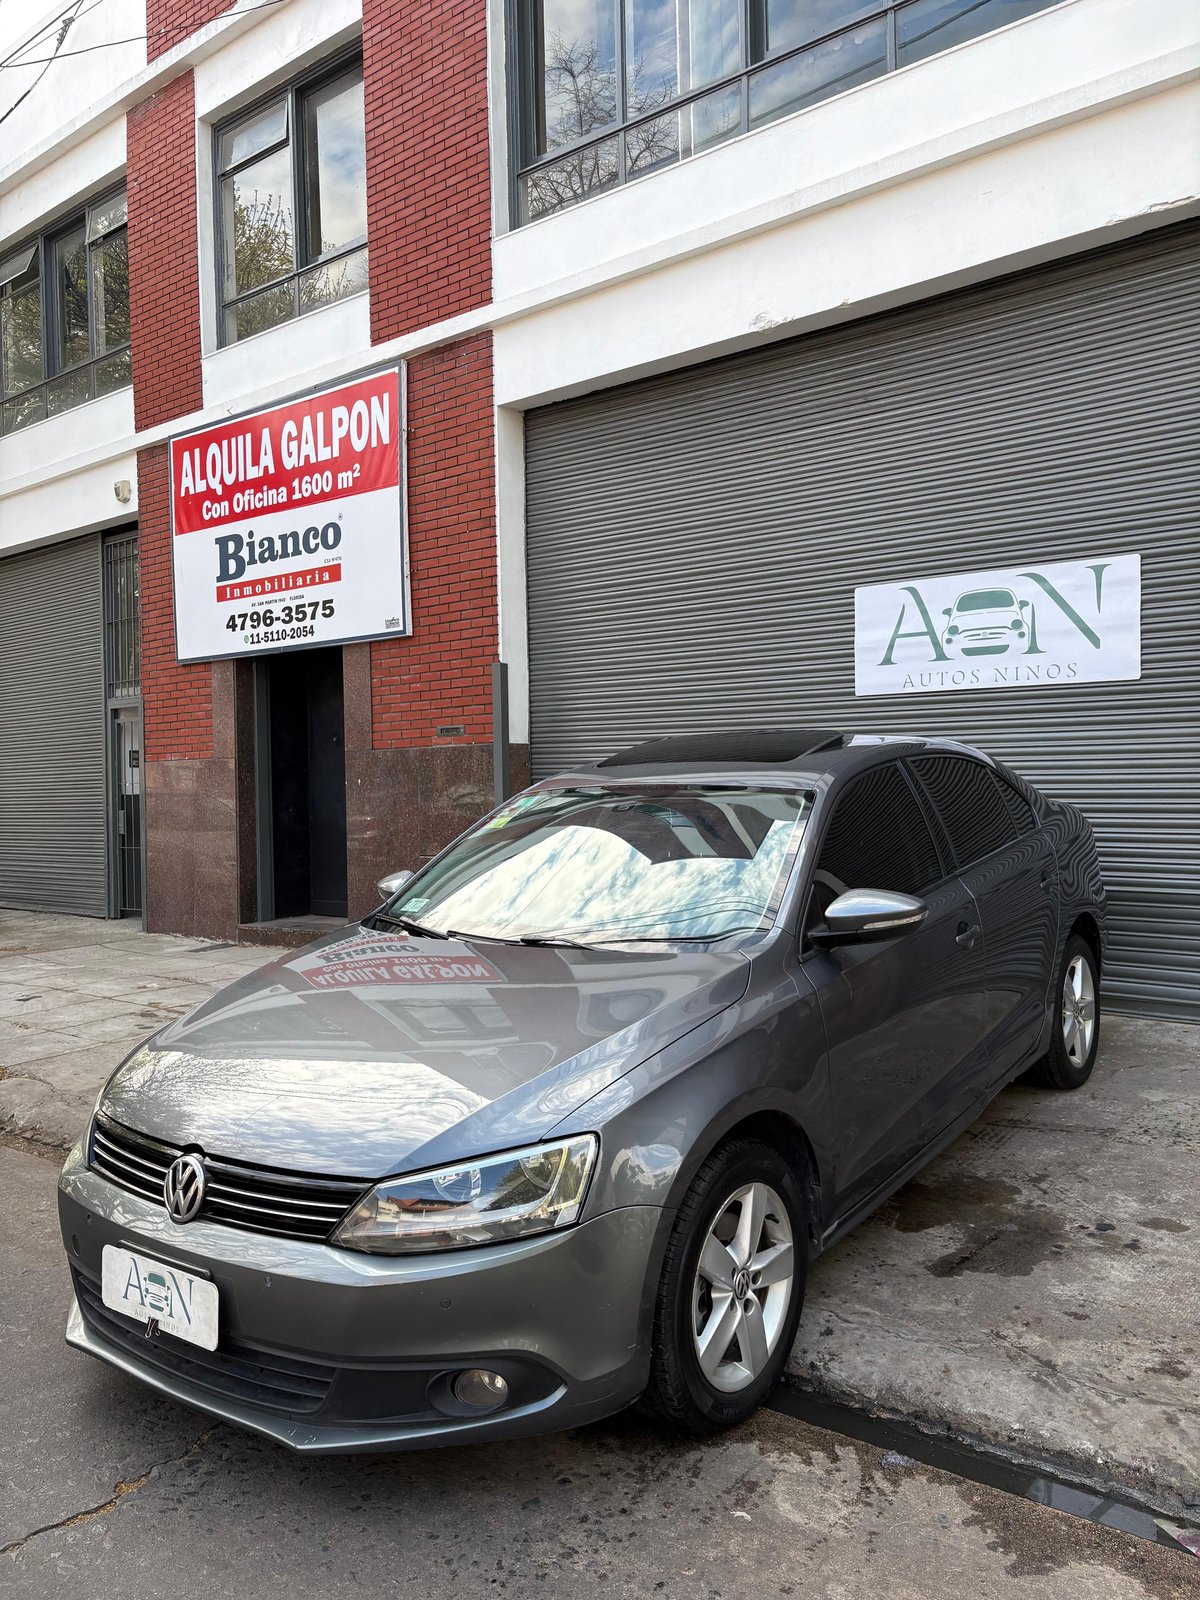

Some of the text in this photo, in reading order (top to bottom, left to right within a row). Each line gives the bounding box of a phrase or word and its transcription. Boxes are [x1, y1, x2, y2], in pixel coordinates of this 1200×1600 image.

[180, 393, 390, 498] ALQUILA GALPON
[202, 493, 229, 521] Con
[233, 485, 287, 514] Oficina
[292, 470, 332, 500] 1600
[215, 520, 342, 583] Bianco
[226, 570, 330, 600] Inmobiliaria
[226, 598, 335, 632] 4796-3575
[249, 625, 315, 645] 11-5110-2054
[902, 662, 1078, 689] AUTOS NINOS
